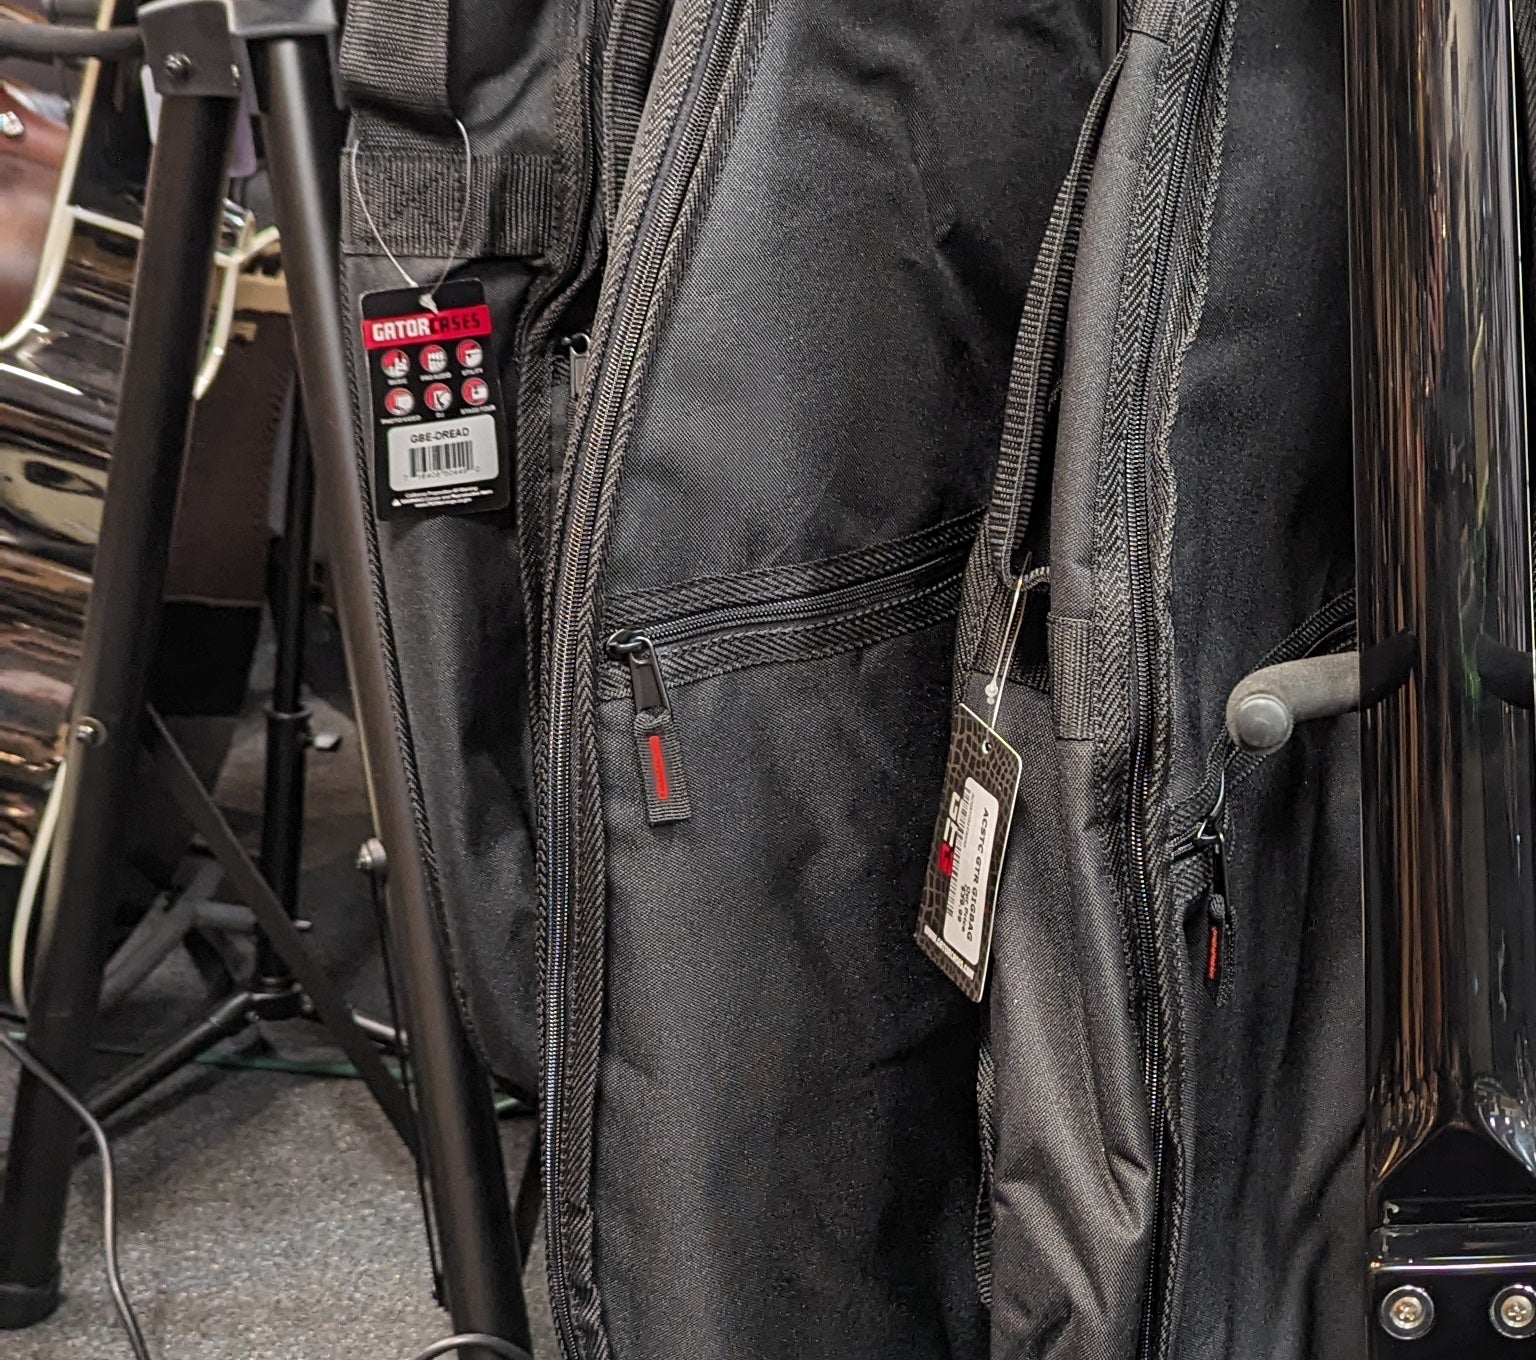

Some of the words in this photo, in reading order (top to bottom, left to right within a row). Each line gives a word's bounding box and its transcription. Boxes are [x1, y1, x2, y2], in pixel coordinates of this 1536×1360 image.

[410, 427, 470, 443] GBE-DREAD
[978, 807, 989, 853] ACSTC
[973, 856, 982, 883] GTR
[966, 886, 978, 942] GIGBAG
